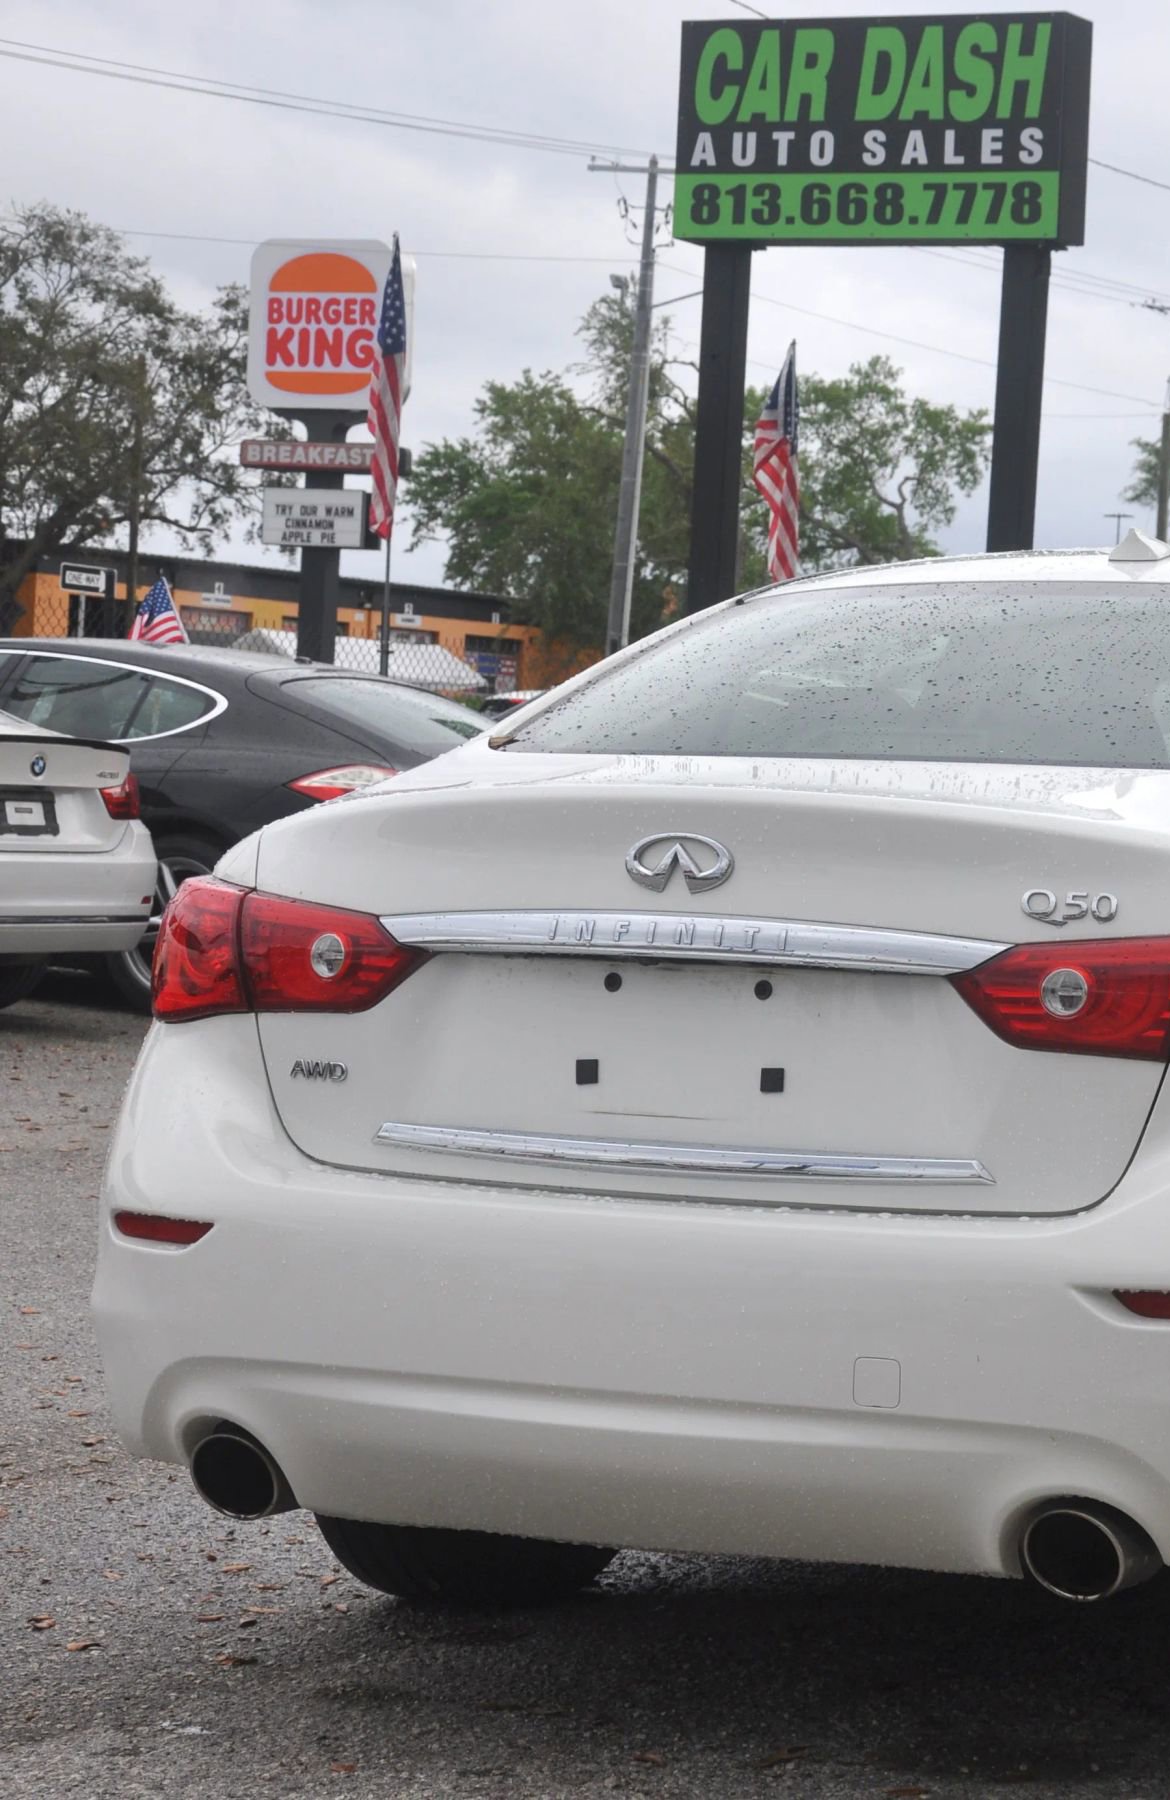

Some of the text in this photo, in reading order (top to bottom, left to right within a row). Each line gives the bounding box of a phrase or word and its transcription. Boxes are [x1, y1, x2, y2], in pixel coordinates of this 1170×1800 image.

[694, 22, 1052, 125] CAR DASH
[690, 127, 1044, 167] AUTO SALES
[690, 181, 1043, 226] 813.668.7778
[267, 297, 377, 326] BURGER
[265, 326, 375, 368] KING
[246, 444, 375, 465] BREAKFAST
[275, 504, 354, 517] TRY OUR WARM
[285, 518, 335, 529] CINNAMON
[281, 531, 336, 544] APPLE PIE
[1021, 889, 1118, 926] Q50
[549, 919, 788, 950] INFINITI
[290, 1060, 348, 1081] AWD
